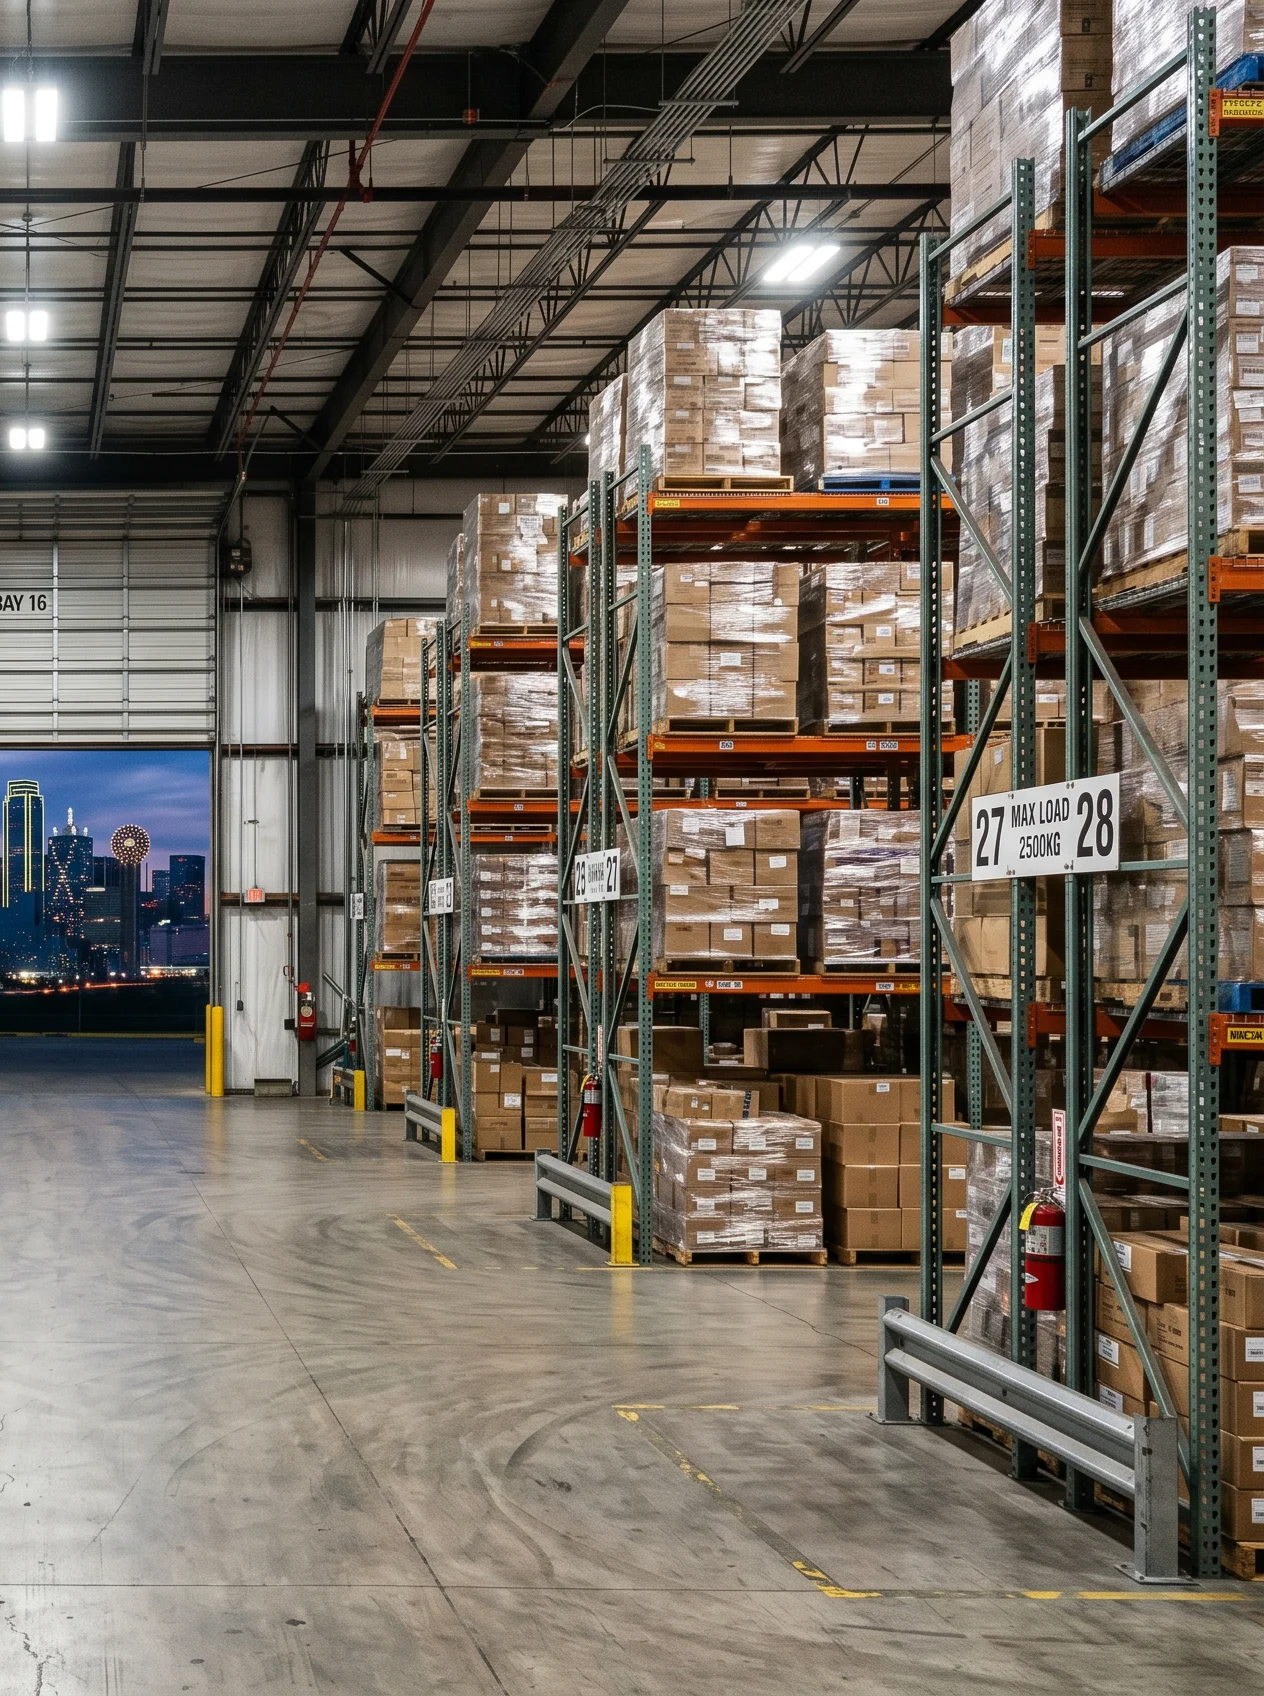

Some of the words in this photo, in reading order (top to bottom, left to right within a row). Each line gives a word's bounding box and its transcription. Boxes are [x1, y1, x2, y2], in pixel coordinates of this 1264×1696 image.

[29, 594, 47, 611] 16
[1011, 802, 1036, 828] MAX
[1039, 797, 1070, 825] LOAD
[1077, 788, 1114, 858] 28
[976, 806, 1005, 867] 27
[1019, 831, 1061, 860] 2500KG
[606, 855, 618, 893] 27
